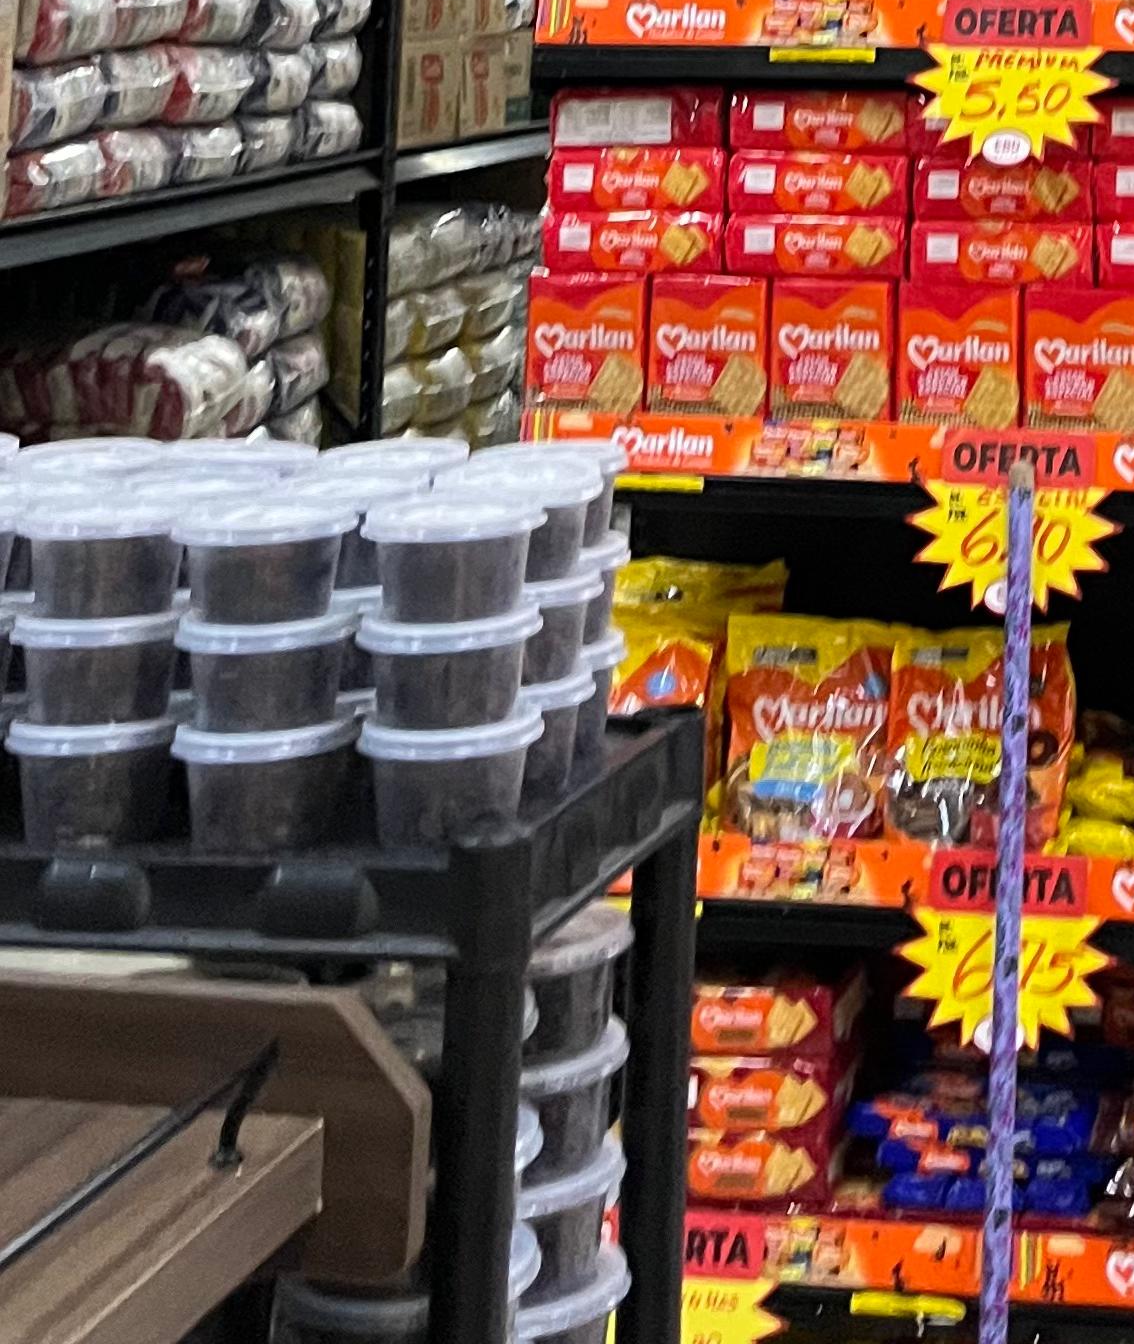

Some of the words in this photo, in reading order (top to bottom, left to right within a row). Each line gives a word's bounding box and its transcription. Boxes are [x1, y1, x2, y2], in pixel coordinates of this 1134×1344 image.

[626, 2, 726, 38] Marilan
[954, 7, 1079, 39] OFERTA
[534, 321, 633, 357] Marilan
[657, 322, 756, 358] Marilan
[778, 323, 880, 359] Marilan
[907, 333, 1009, 370] Marilan
[942, 864, 1075, 904] OFTA
